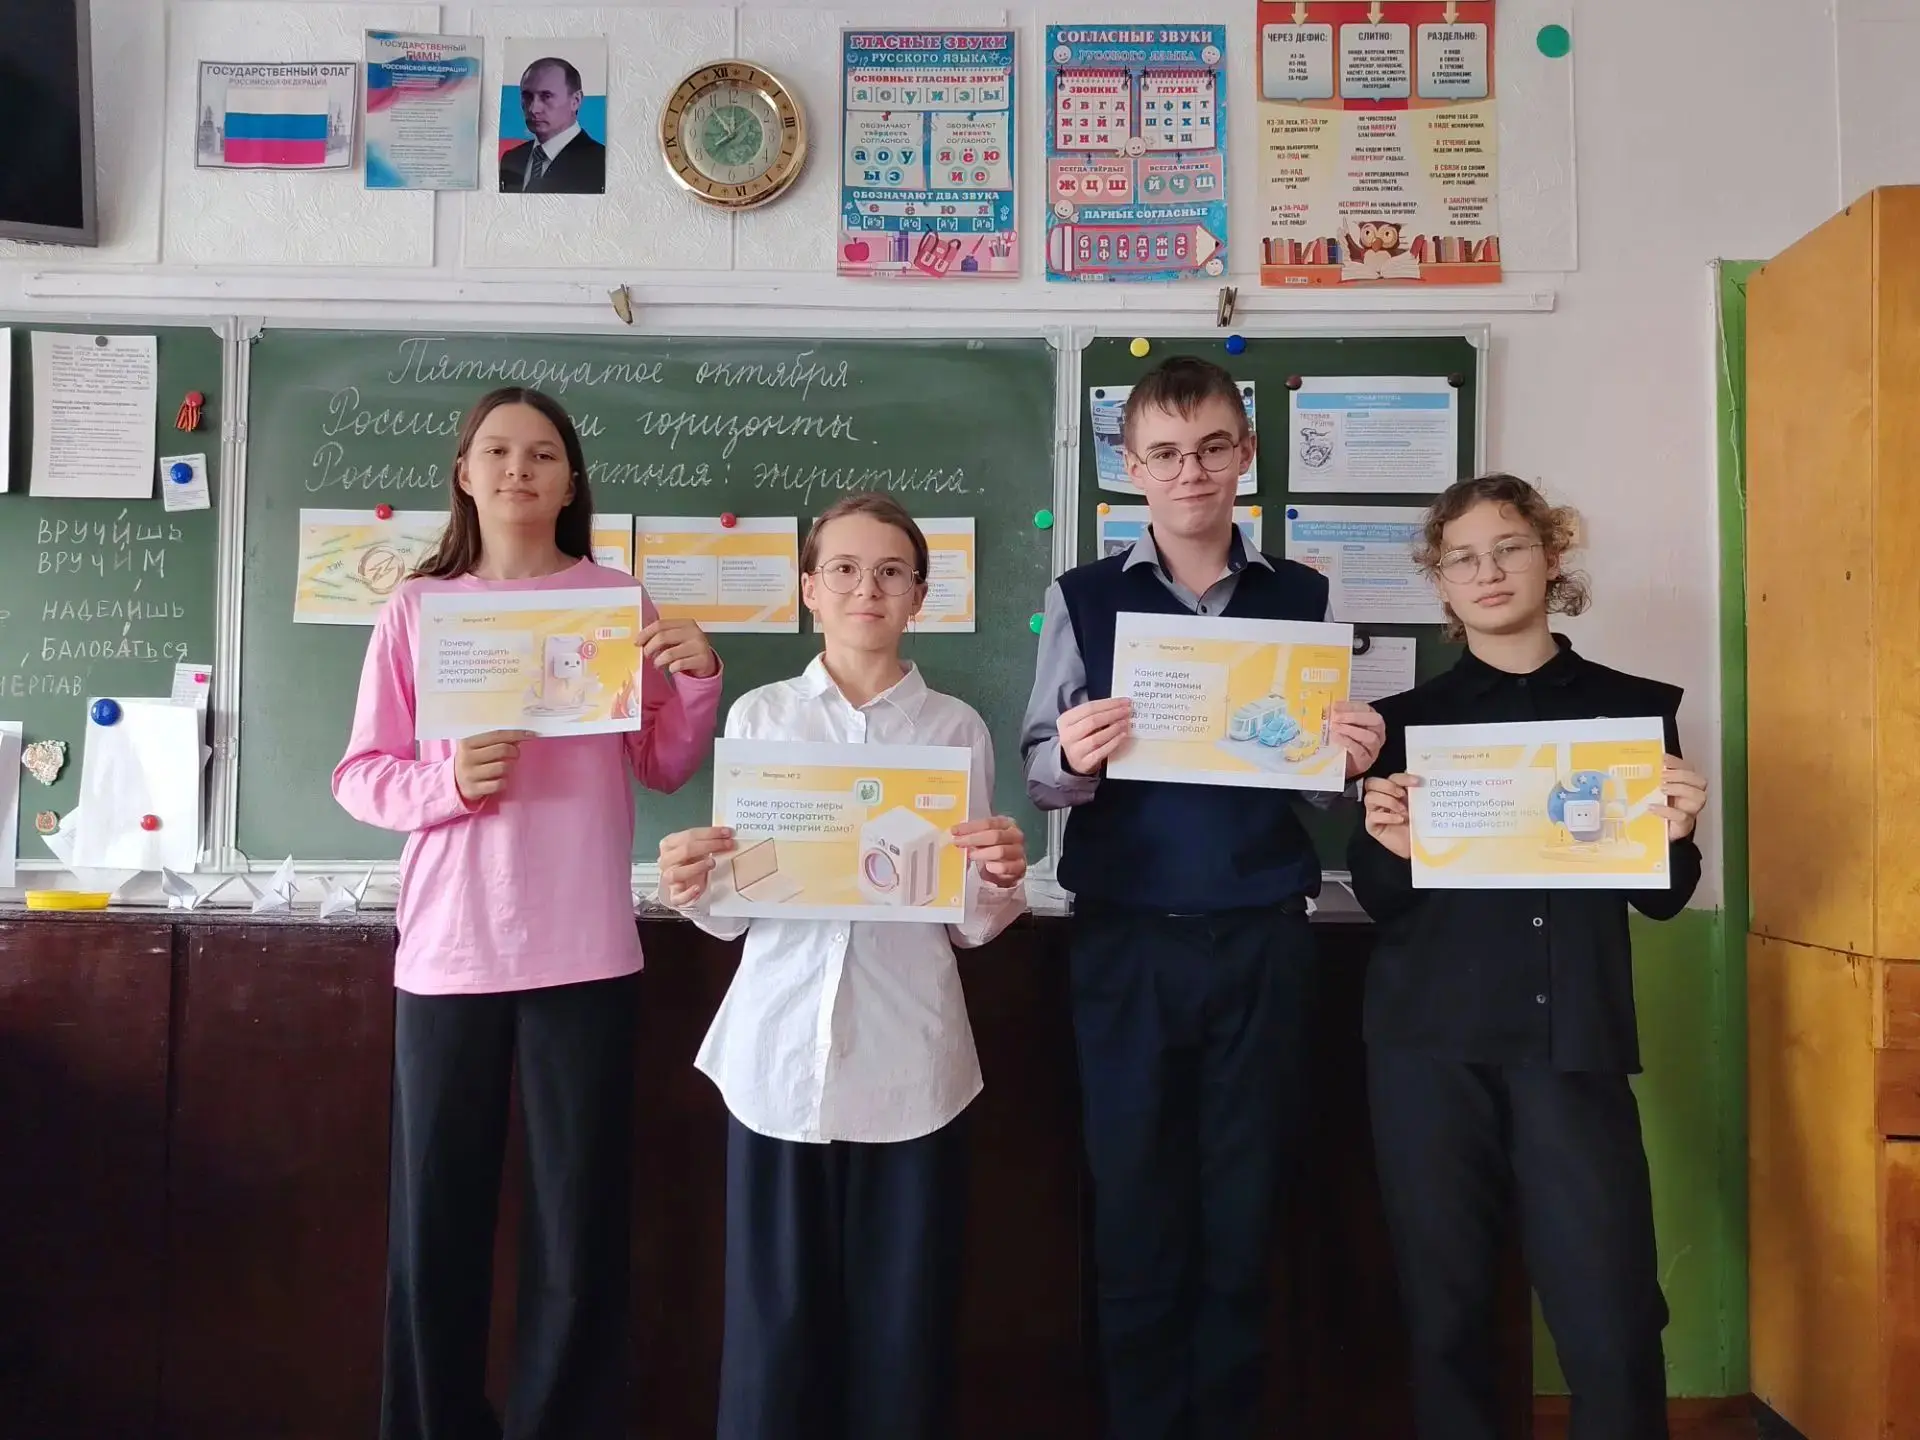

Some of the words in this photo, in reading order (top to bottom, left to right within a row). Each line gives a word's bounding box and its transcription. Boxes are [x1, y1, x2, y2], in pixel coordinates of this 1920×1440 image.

[1057, 31, 1154, 43] СОГЛАСНЫЕ
[1159, 31, 1213, 43] ЗВУКИ
[1268, 33, 1293, 42] ЧЕРЕЗ
[1296, 32, 1328, 43] ДЕФИС:
[1358, 32, 1392, 40] СЛИТНО:
[1427, 32, 1478, 42] РАЗДЕЛЬНО:
[380, 39, 467, 51] ГОСУДАРСТВЕННЫЙ
[850, 35, 941, 50] ГЛАСНЫЕ
[945, 36, 1007, 49] ЗВУКИ
[406, 51, 441, 60] ГИМН
[872, 53, 938, 63] РУССКОГО
[943, 54, 987, 63] ЯЗЫКА
[1079, 50, 1147, 61] РУССКОГО
[1150, 50, 1196, 61] ЯЗЫКА
[206, 64, 318, 77] ГОСУДАРСТВЕННЫЙ
[320, 66, 350, 77] ФЛАГ
[229, 78, 281, 86] РОССИЙСКОЙ
[282, 78, 327, 86] ФЕДЕРАЦИИ
[854, 75, 914, 83] ОСНОВНЫЕ
[1069, 86, 1118, 94] ЗВОНКИЕ
[1157, 86, 1199, 94] ГЛУХИЕ
[728, 89, 738, 104] 12
[1062, 98, 1071, 110] б
[1080, 102, 1090, 110] в
[1115, 101, 1126, 111] д
[1163, 100, 1174, 111] ф
[1182, 101, 1192, 109] к
[1061, 118, 1073, 127] ж
[1080, 118, 1089, 127] з
[1097, 116, 1107, 127] й
[1145, 118, 1157, 127] ш
[1164, 118, 1173, 127] с
[1182, 118, 1192, 127] х
[1200, 117, 1210, 126] ц
[1063, 134, 1073, 145] р
[1080, 134, 1090, 143] н
[1096, 134, 1109, 143] м
[1164, 135, 1174, 143] ч
[855, 150, 866, 161] а
[878, 151, 889, 161] о
[901, 151, 914, 164] у
[940, 151, 951, 161] я
[963, 149, 974, 162] ё
[984, 151, 1000, 161] ю
[864, 171, 880, 181] ы
[890, 171, 900, 181] э
[952, 172, 963, 181] и
[975, 172, 985, 181] е
[853, 191, 934, 200] ОБОЗНАЧАЮТ
[936, 192, 960, 201] ДВА
[963, 192, 1000, 200] ЗВУКА
[869, 204, 880, 213] е
[905, 203, 916, 215] ё
[941, 205, 956, 215] ю
[978, 205, 989, 215] я
[1085, 210, 1134, 219] ПАРНЫЕ
[1136, 208, 1208, 218] СОГЛАСНЫЕ
[387, 338, 664, 394] Пятнадцатое
[696, 350, 863, 401] октября.
[322, 386, 461, 437] Россия
[636, 411, 878, 459] горизонты.
[305, 441, 445, 492] Россия
[440, 639, 474, 648] Почему
[472, 649, 510, 657] следить
[452, 658, 520, 666] исправностью
[438, 667, 519, 675] электроприборов
[1134, 668, 1163, 678] Какие
[447, 675, 487, 684] техники?
[1154, 682, 1202, 690] экономии
[1133, 691, 1173, 700] энергии
[1174, 693, 1207, 701] можно
[1132, 702, 1190, 711] предложить
[1151, 713, 1208, 723] транспорта
[1172, 725, 1211, 733] городе?
[1430, 779, 1468, 788] Почему
[1430, 790, 1480, 798] оставлять
[736, 798, 768, 808] Какие
[771, 800, 814, 810] простые
[816, 802, 843, 811] меры
[1431, 799, 1515, 808] электроприборы
[736, 811, 778, 821] помогут
[779, 813, 835, 822] сократить
[1431, 810, 1501, 818] включёнными
[736, 822, 774, 832] расход
[777, 825, 821, 833] энергии
[823, 825, 855, 833] дома?
[1431, 820, 1449, 828] без
